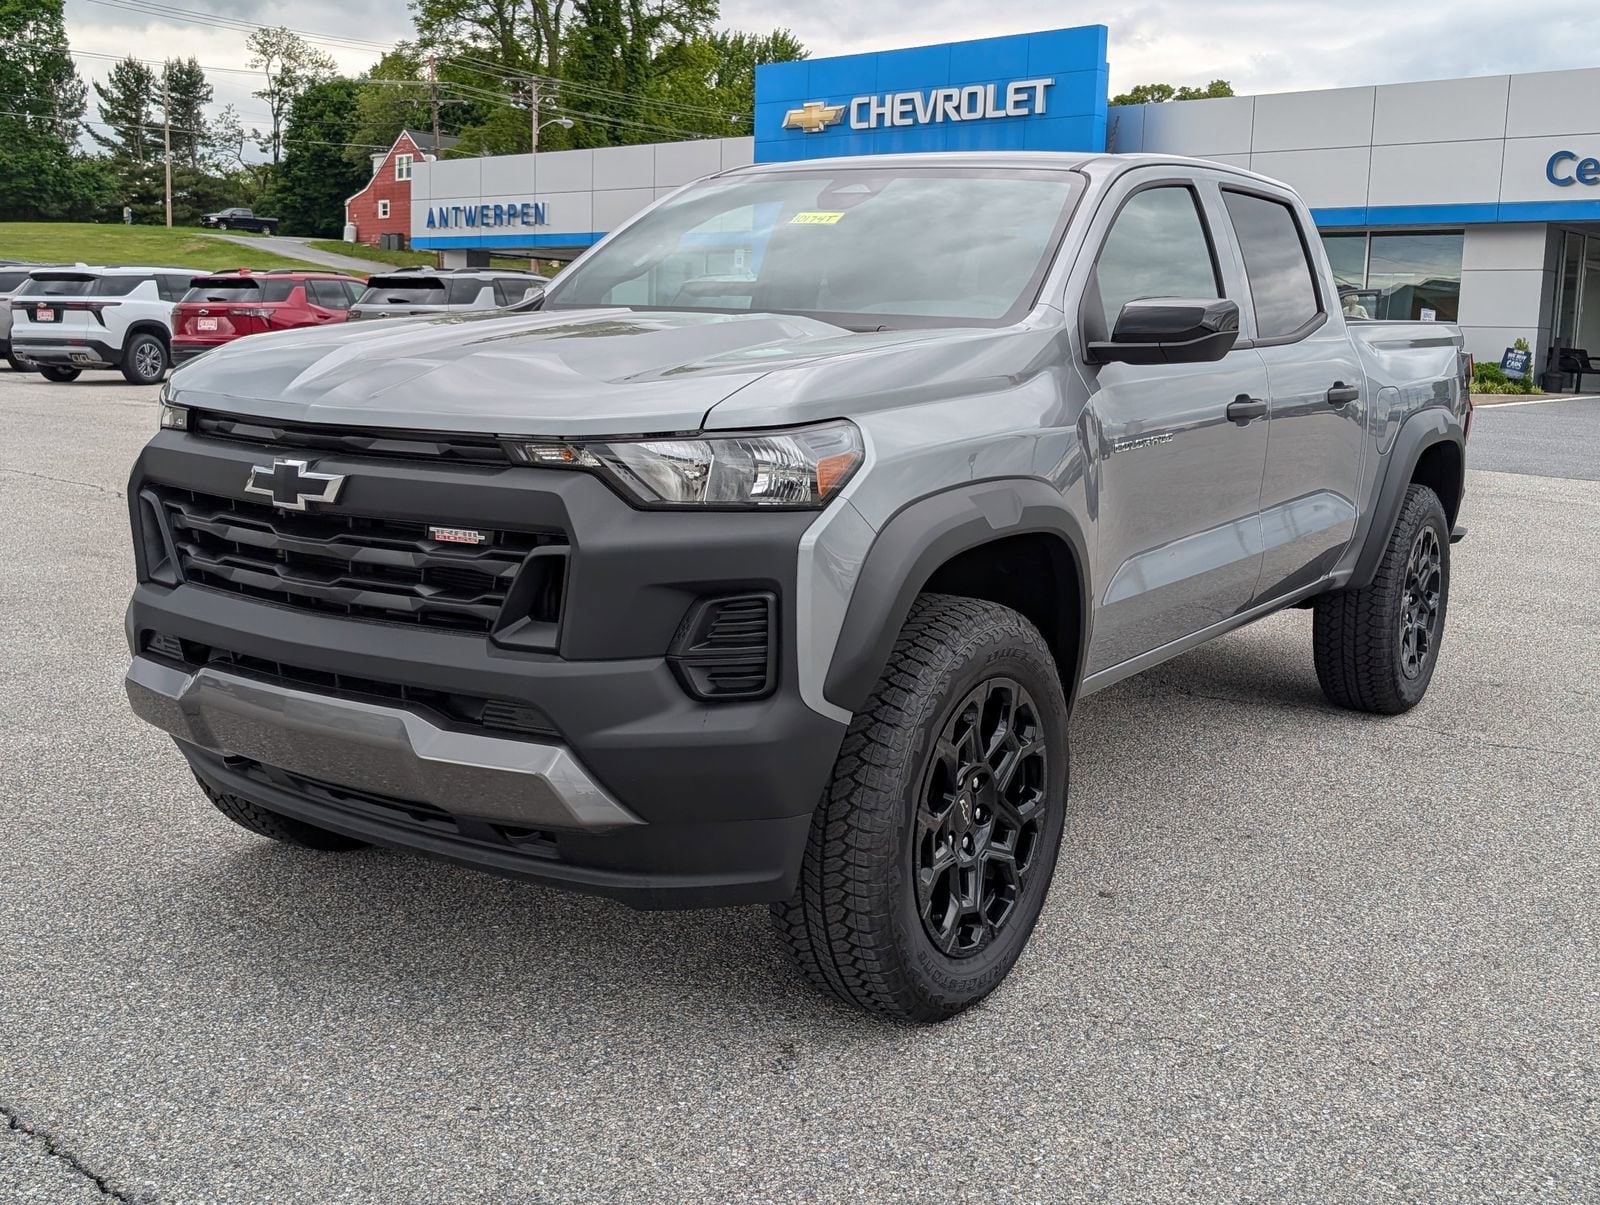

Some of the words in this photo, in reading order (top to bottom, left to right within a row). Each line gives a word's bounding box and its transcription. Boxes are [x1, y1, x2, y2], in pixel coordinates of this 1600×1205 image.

[850, 78, 1055, 130] CHEVROLET
[1546, 150, 1600, 187] Ce
[426, 202, 548, 229] ANTWERPEN
